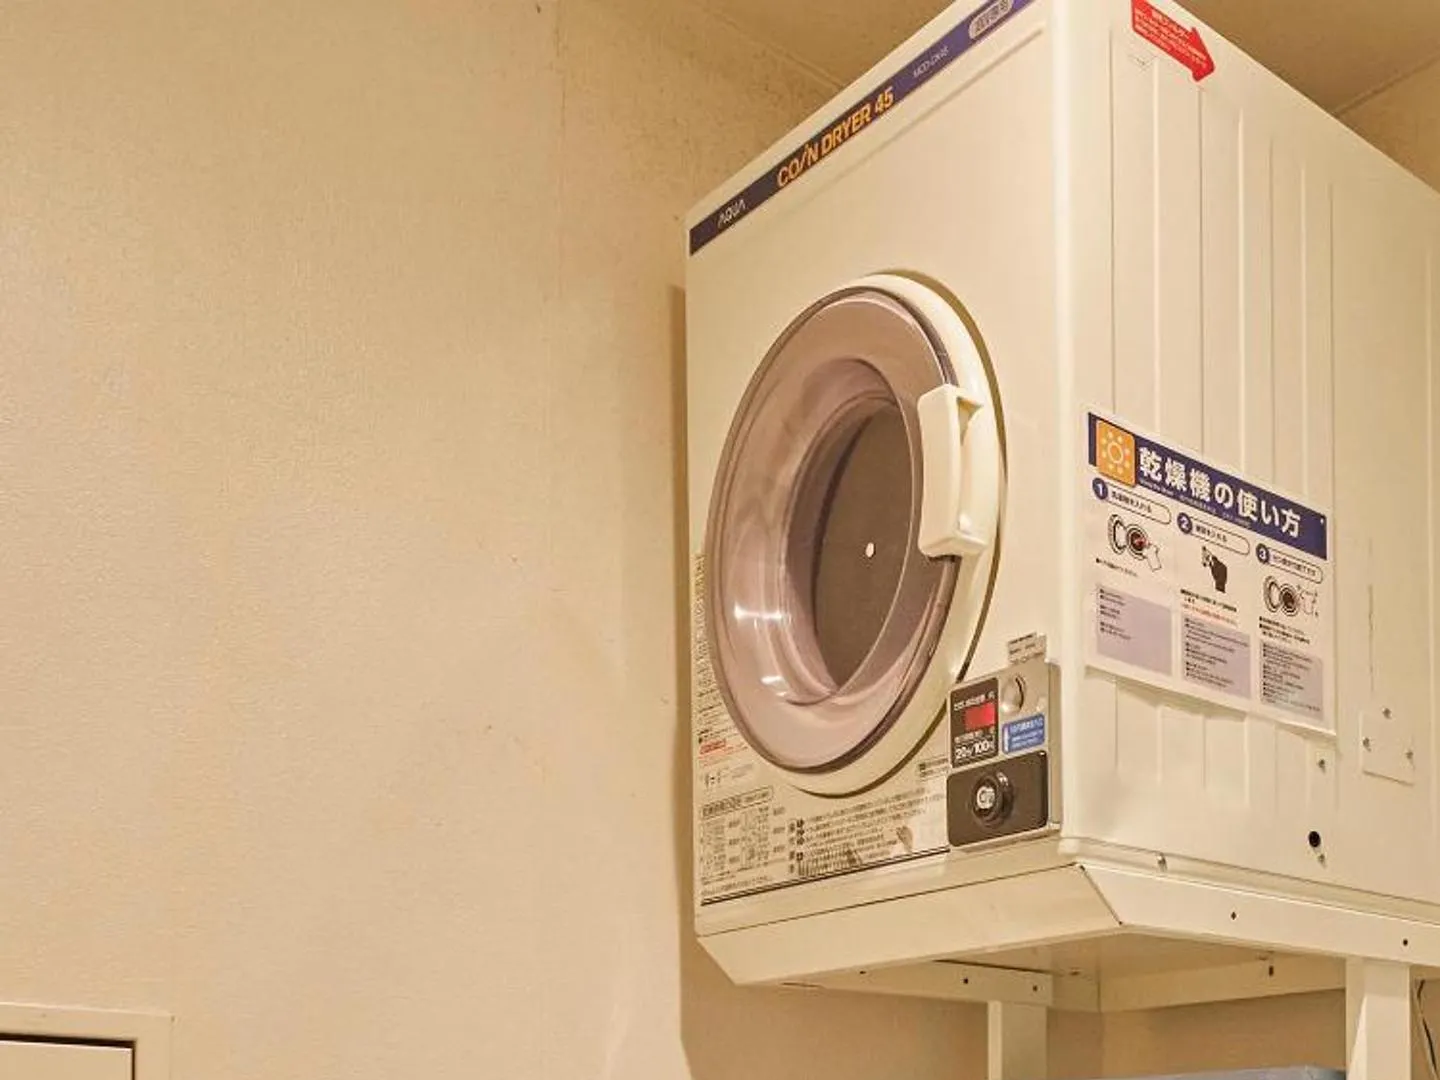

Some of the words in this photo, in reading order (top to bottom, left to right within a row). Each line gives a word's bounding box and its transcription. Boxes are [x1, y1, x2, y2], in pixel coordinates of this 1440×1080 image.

[822, 105, 872, 156] DRYER
[875, 86, 895, 114] 45
[1138, 447, 1301, 538] 乾燥機の使い方
